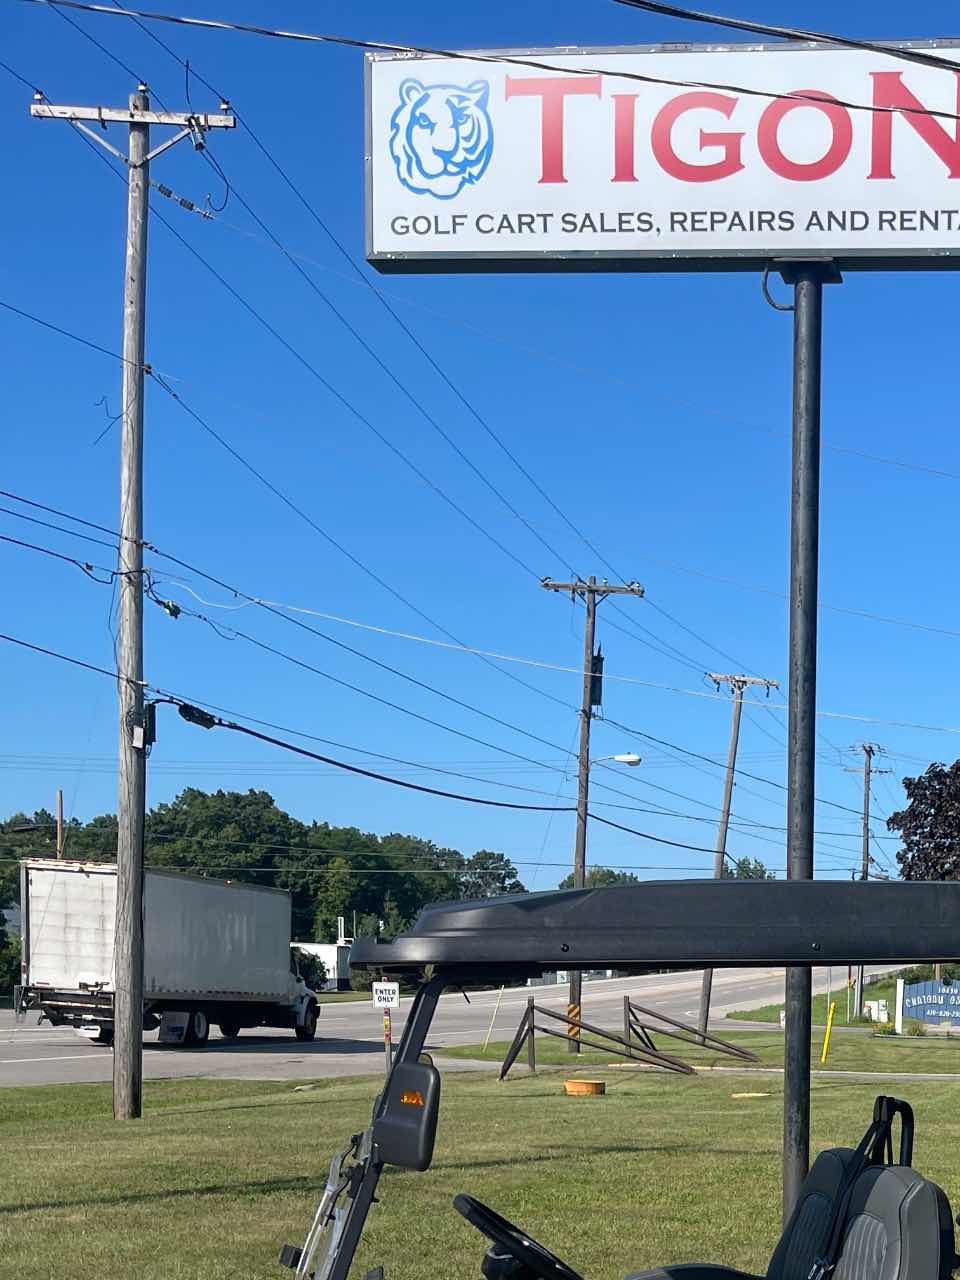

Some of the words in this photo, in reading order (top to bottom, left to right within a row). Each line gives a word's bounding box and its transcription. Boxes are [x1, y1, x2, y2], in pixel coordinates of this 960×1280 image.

[390, 214, 468, 235] GOLF
[475, 213, 553, 234] CART
[561, 211, 662, 236] SALES,
[669, 210, 795, 233] REPAIRS
[805, 210, 870, 231] AND
